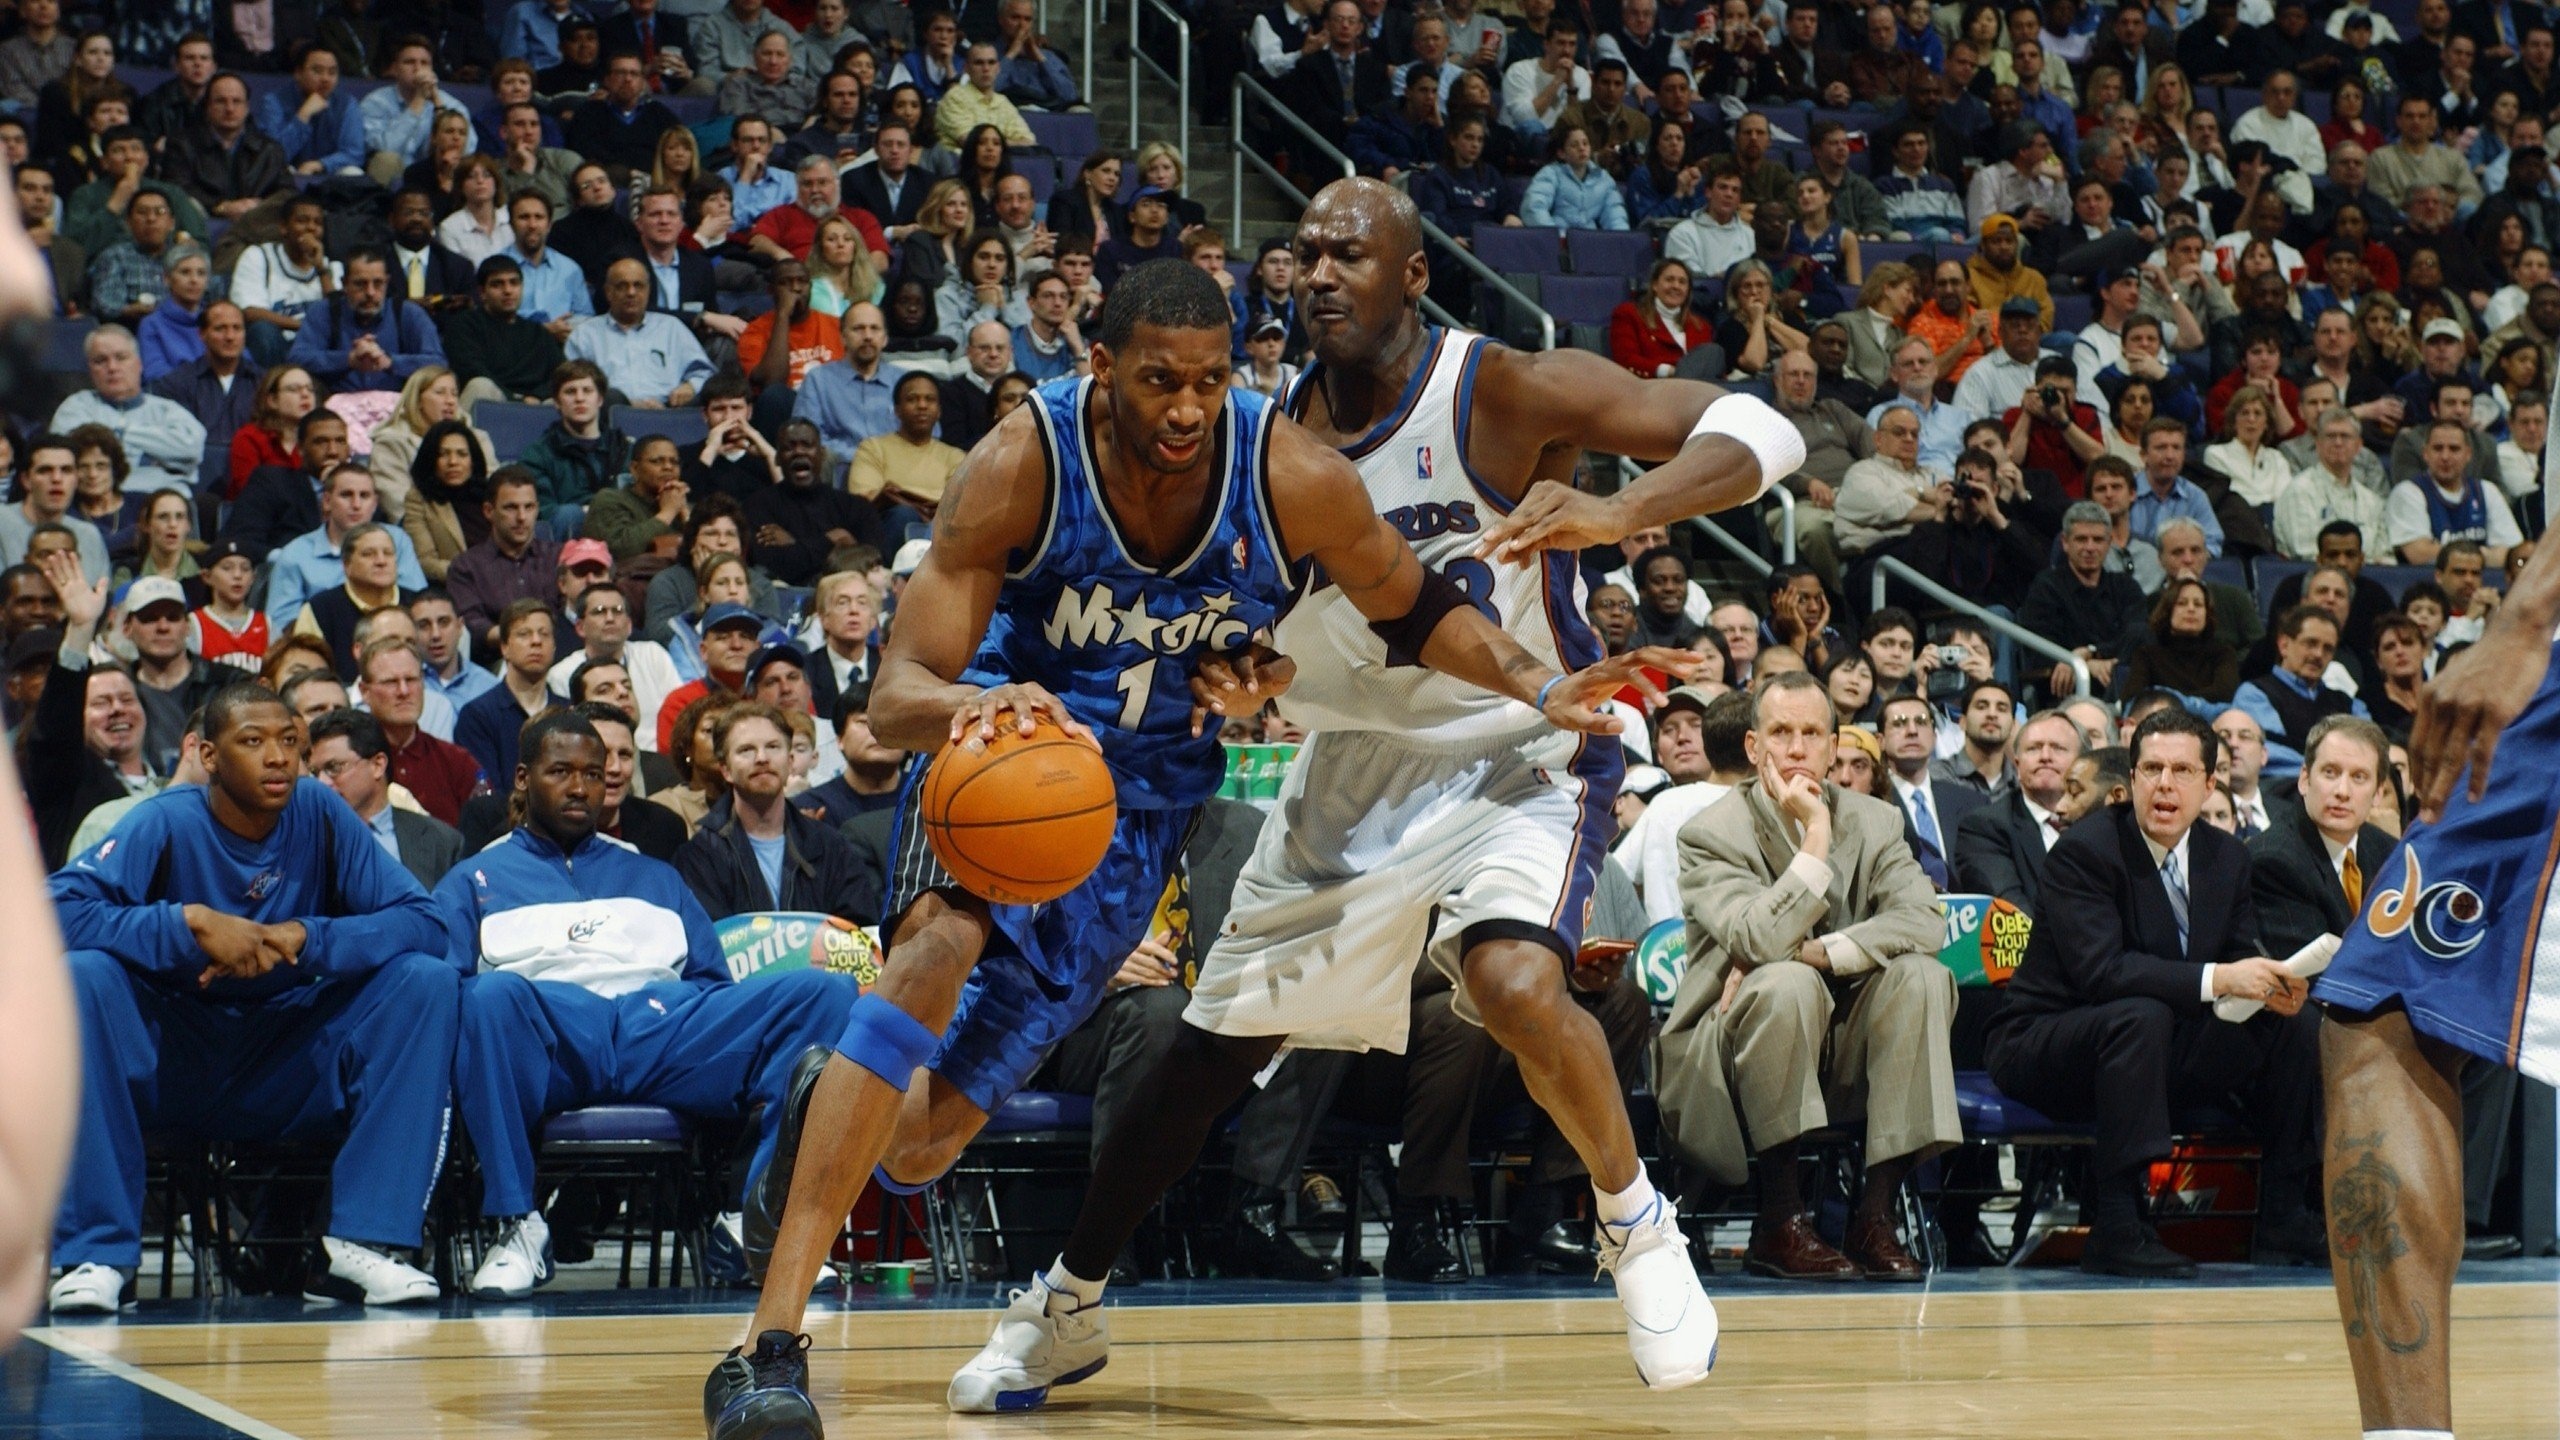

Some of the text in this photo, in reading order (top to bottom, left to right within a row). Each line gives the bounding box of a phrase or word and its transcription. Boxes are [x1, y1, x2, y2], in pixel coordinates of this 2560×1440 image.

[1383, 500, 1481, 541] RDS
[1117, 657, 1158, 735] 1
[720, 926, 748, 949] Enjoy
[823, 928, 874, 953] OBEY
[726, 920, 808, 984] prite
[828, 951, 870, 967] YOUR
[1993, 947, 2024, 968] THI
